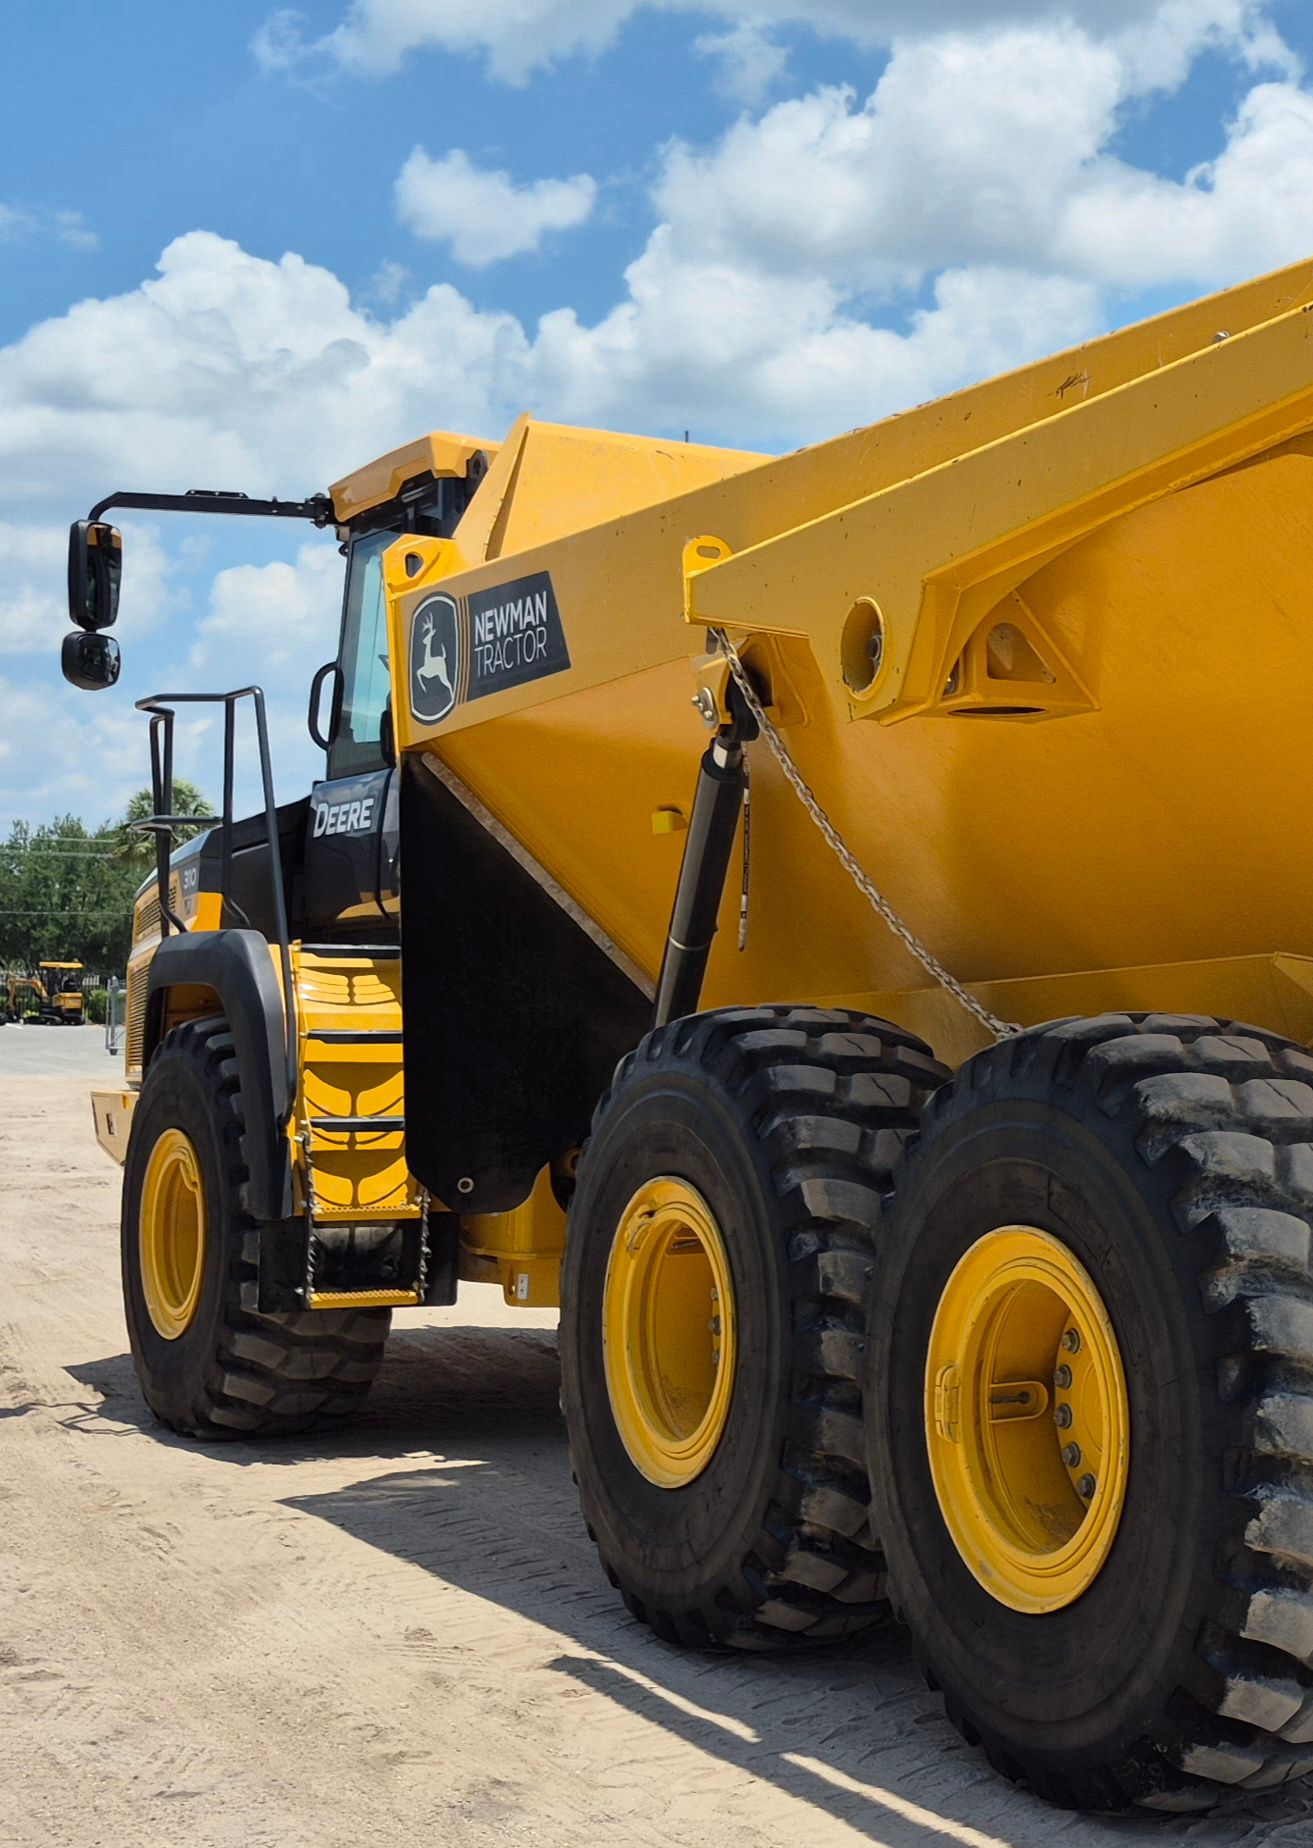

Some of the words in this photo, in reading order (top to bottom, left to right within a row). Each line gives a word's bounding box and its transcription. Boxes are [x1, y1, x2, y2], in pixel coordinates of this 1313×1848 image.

[475, 591, 548, 644] NEWMAN
[474, 626, 548, 678] TRACTOR
[313, 798, 375, 839] DEERE
[184, 867, 197, 890] 310
